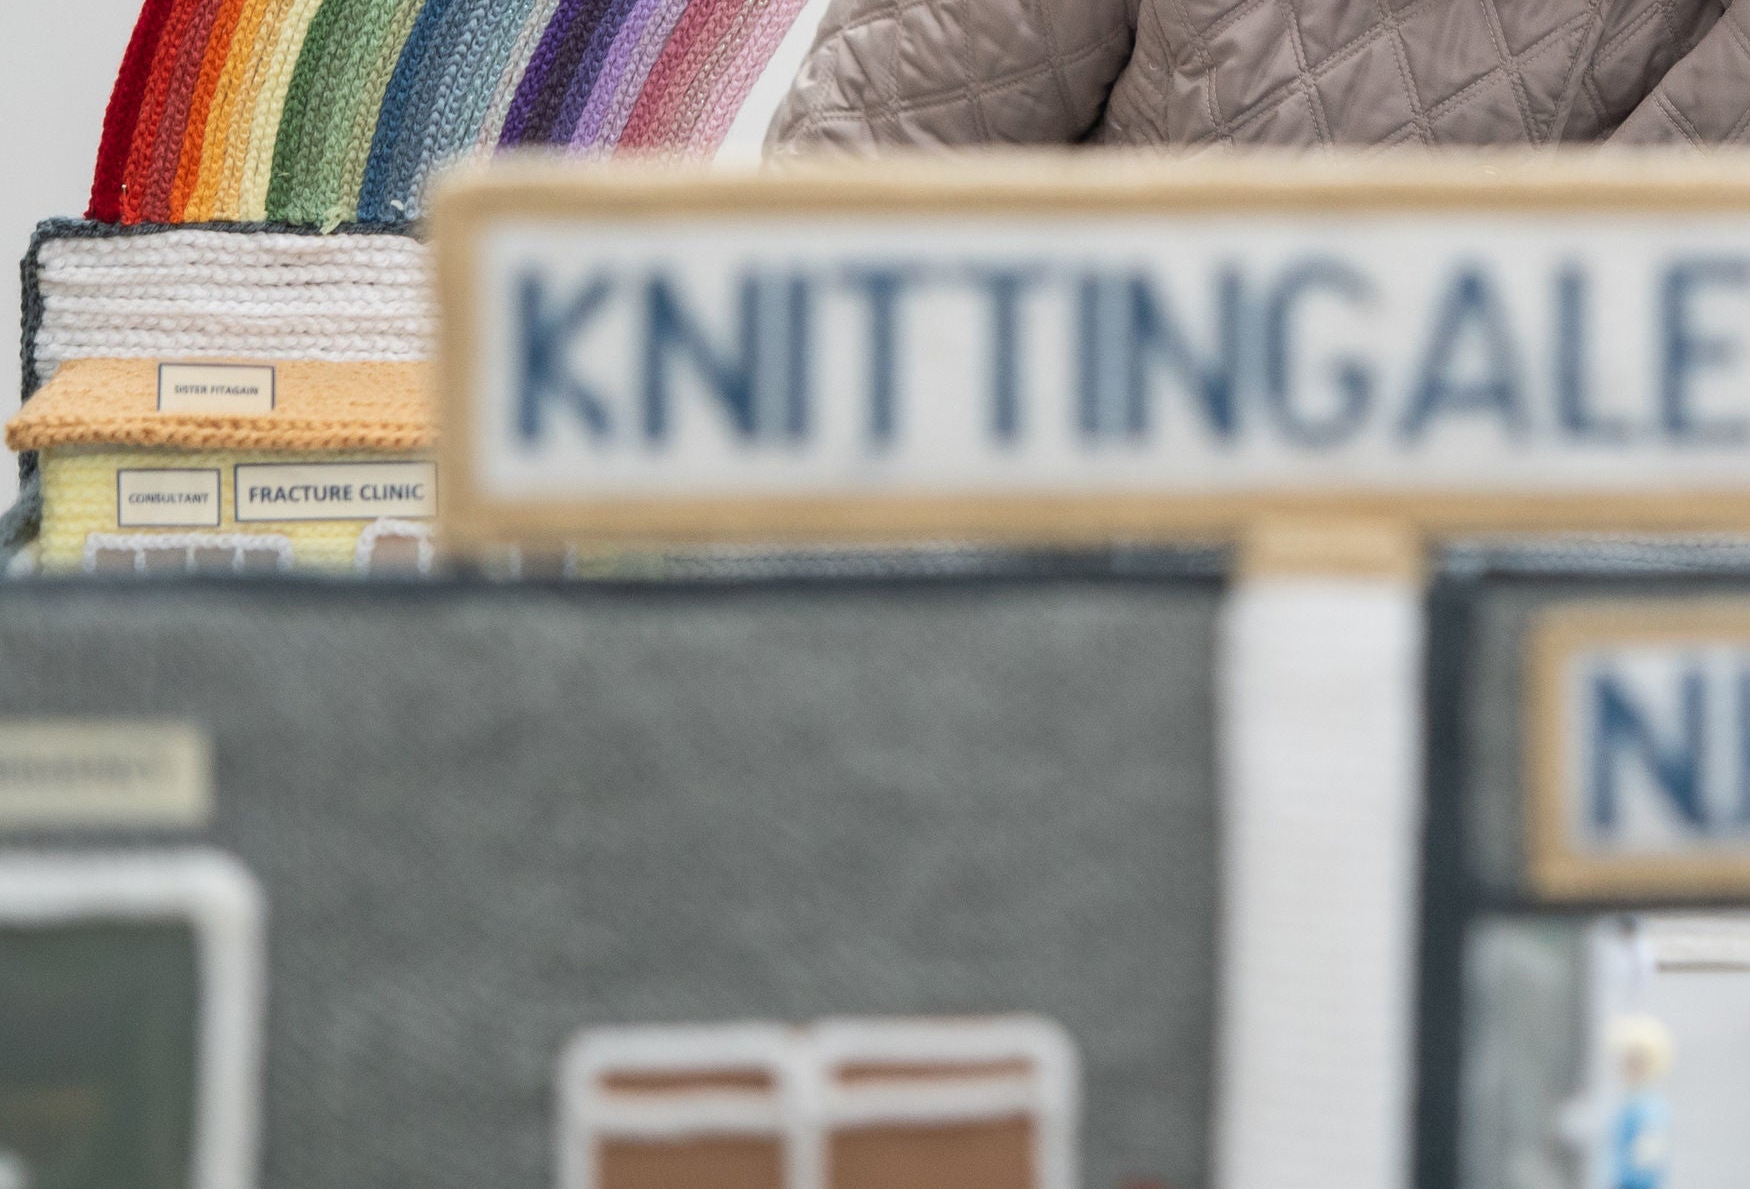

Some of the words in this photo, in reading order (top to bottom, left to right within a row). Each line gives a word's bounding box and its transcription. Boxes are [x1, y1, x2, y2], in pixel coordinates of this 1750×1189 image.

[174, 384, 208, 395] SISTER
[128, 492, 209, 505] CONSULTANT
[249, 484, 353, 503] FRACTURE
[359, 483, 425, 501] CLINIC
